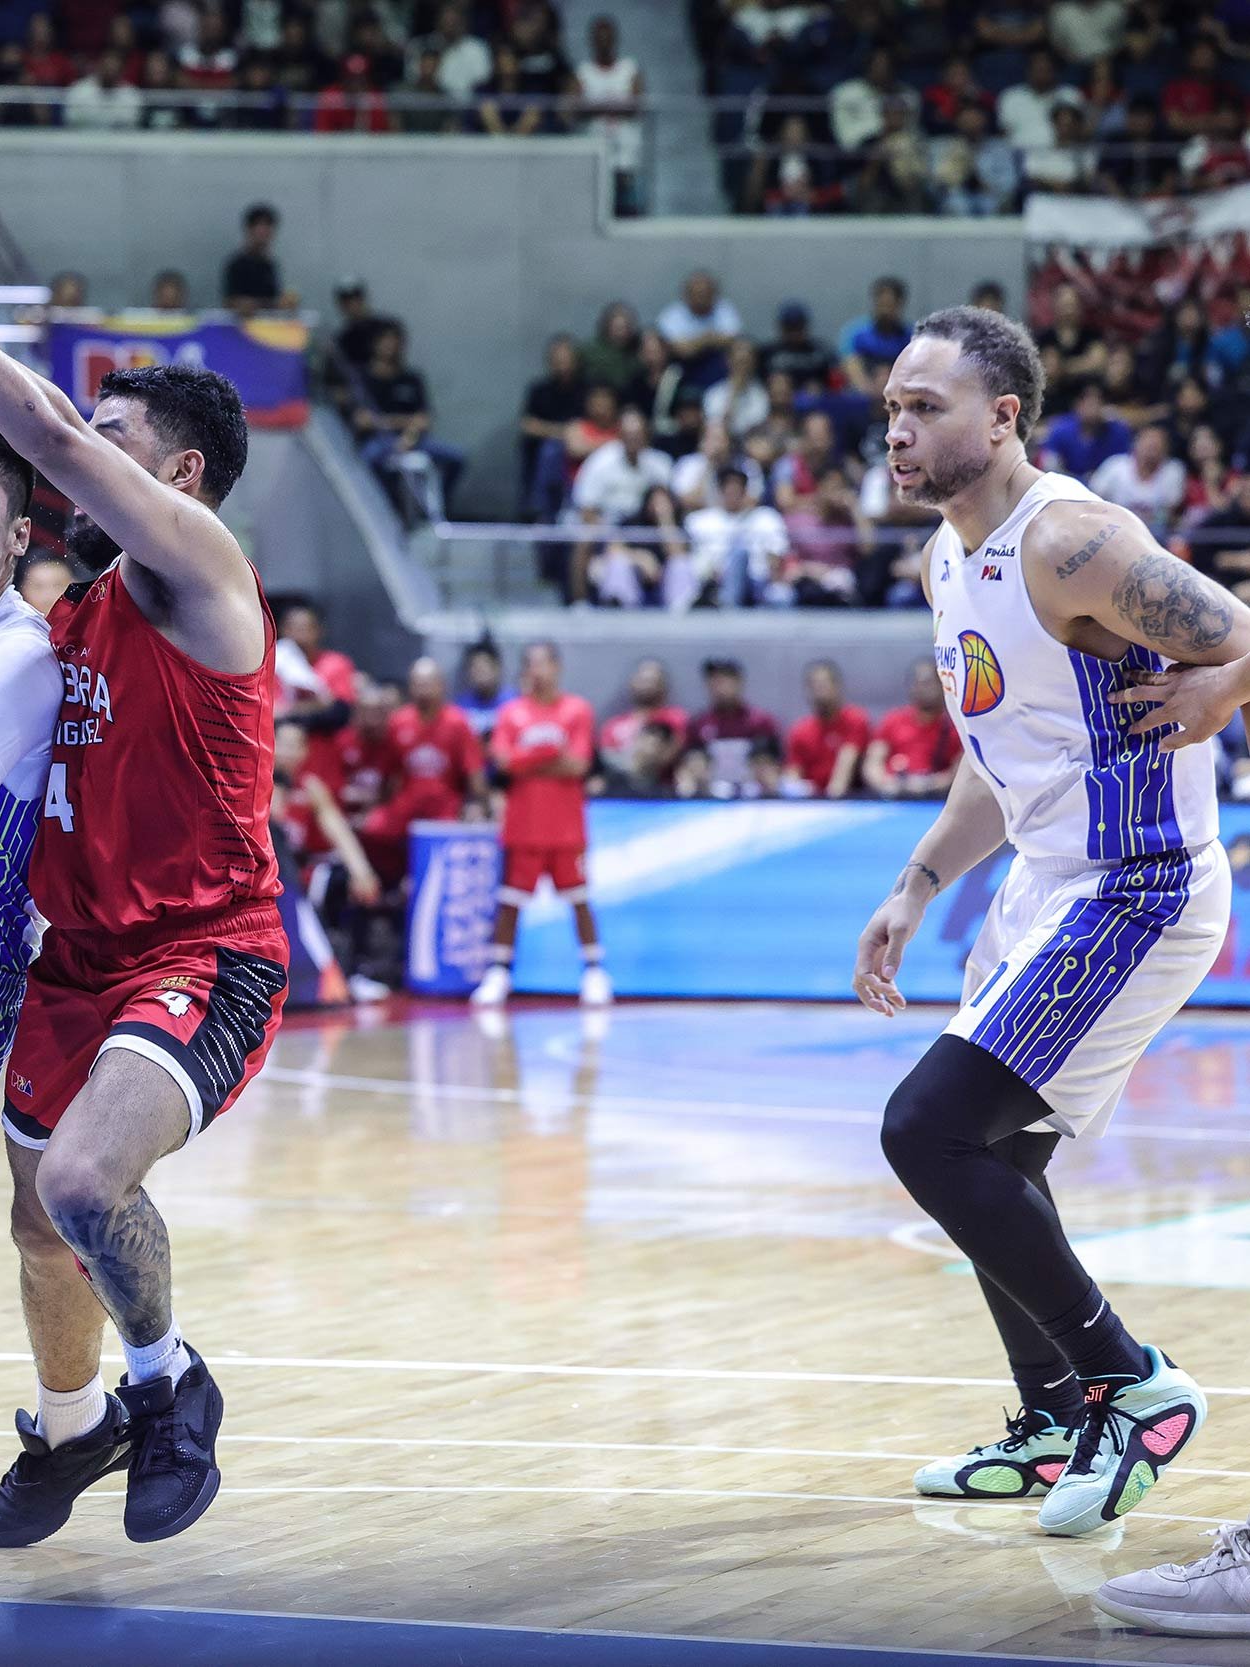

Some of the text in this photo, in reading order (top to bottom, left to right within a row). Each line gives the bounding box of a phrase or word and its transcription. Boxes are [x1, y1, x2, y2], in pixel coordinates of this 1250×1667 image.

[984, 546, 1016, 558] FINALS
[981, 564, 1003, 581] PBA
[60, 661, 114, 723] BRA
[56, 718, 102, 746] IGUEL
[45, 762, 75, 832] 4
[153, 990, 193, 1018] 4
